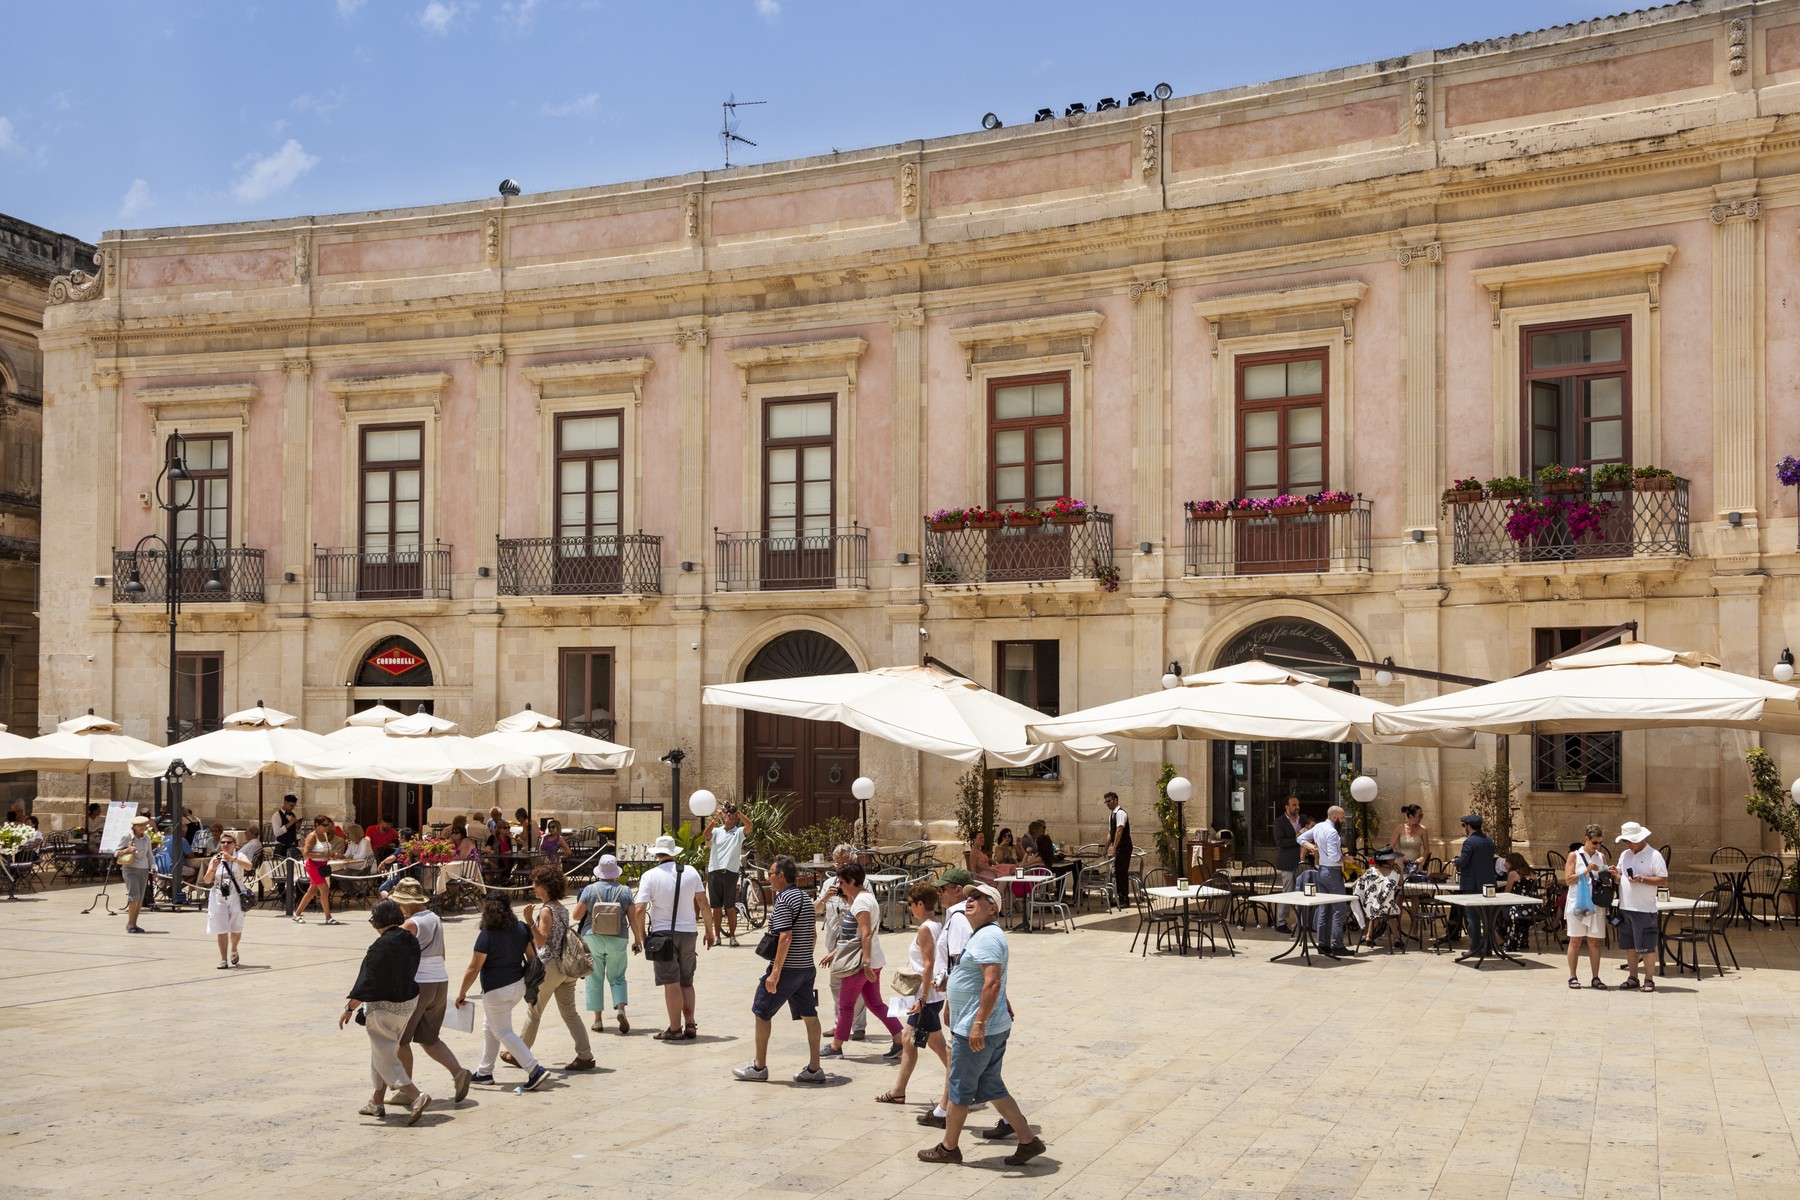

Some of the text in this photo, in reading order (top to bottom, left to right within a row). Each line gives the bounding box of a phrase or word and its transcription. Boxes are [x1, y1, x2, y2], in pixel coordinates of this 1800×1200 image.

[1227, 641, 1253, 666] Gran
[1290, 625, 1310, 637] del
[1312, 628, 1345, 660] Duom
